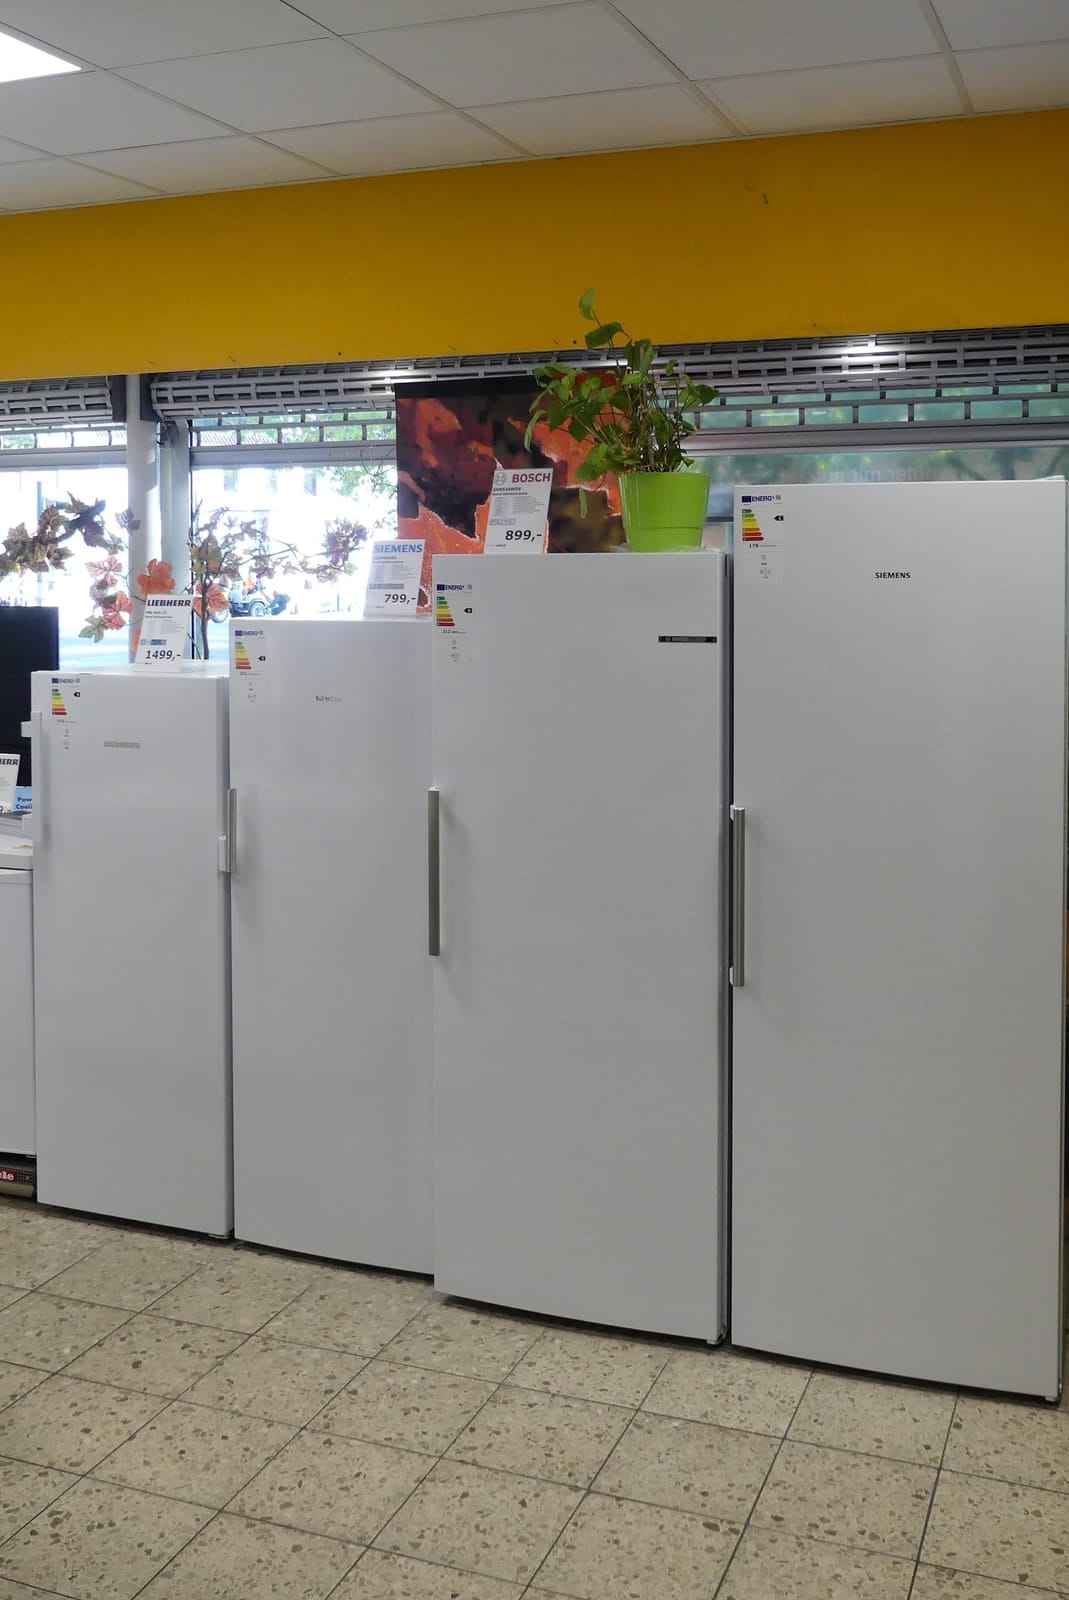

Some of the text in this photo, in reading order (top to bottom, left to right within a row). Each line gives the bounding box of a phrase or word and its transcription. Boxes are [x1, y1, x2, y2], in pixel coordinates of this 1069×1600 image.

[512, 472, 551, 483] BOSCH
[505, 529, 542, 542] 899,-
[374, 543, 423, 553] SIEMENS
[874, 571, 911, 579] SIEMENS
[147, 599, 191, 607] LIEBHERR
[384, 593, 417, 605] 799,-
[145, 649, 181, 662] 1499,-
